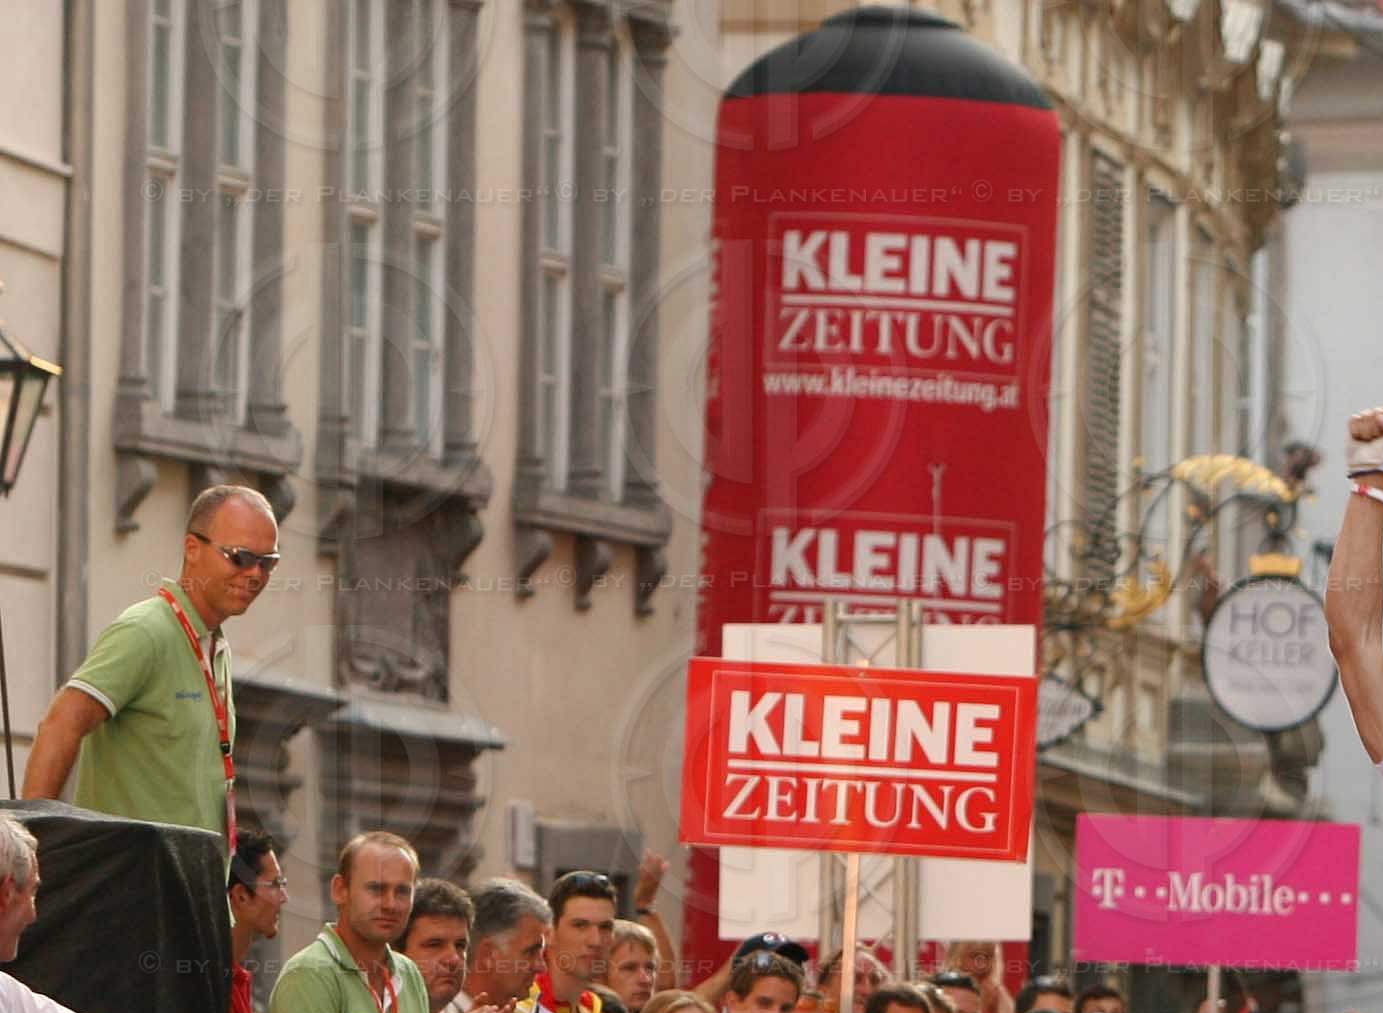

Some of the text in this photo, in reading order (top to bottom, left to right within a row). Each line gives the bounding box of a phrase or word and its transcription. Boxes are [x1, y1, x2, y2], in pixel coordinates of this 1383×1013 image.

[781, 229, 1018, 302] KLEINE
[778, 306, 1014, 364] ZEITUNG
[771, 526, 1006, 598] KLEINE
[1229, 602, 1316, 639] HOF
[727, 690, 1001, 768] KLEINE
[722, 772, 998, 834] ZEITUNG
